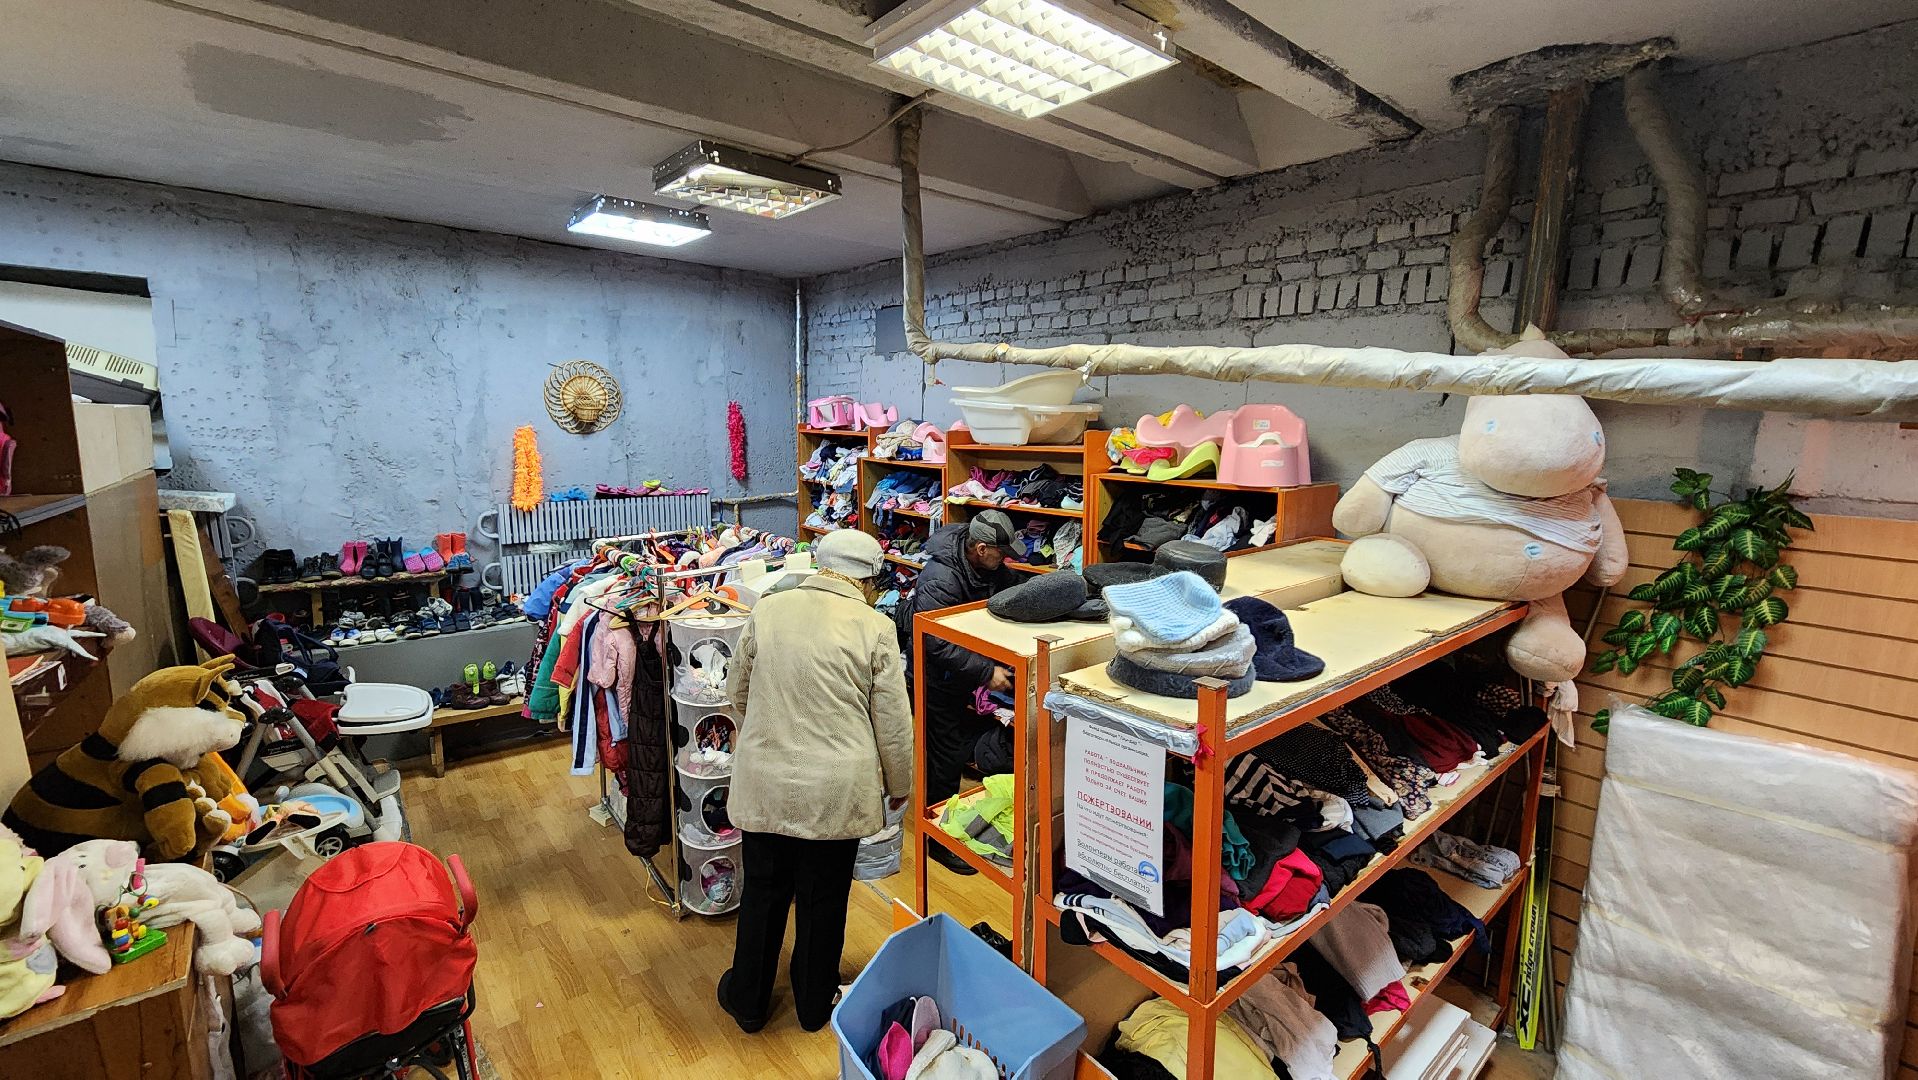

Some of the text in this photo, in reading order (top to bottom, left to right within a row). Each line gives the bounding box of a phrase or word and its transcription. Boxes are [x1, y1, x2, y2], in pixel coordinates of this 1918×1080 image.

[1084, 749, 1104, 761] РАБОТА
[1083, 757, 1150, 788] ПОЛНОСТЬЮ СУЩЕСТВУЕТ
[1090, 769, 1125, 787] ПРОДОЛЖАЕТ
[1126, 783, 1147, 796] РАБОТУ
[1085, 775, 1104, 788] ТОЛЬКО
[1113, 788, 1127, 798] СЧЕТ
[1076, 802, 1084, 810] На
[1092, 809, 1105, 819] идут
[1076, 838, 1113, 860] Волонтеры
[1077, 851, 1112, 873] абсолютно
[1529, 905, 1537, 948] crown
[1524, 948, 1535, 986] ridge
